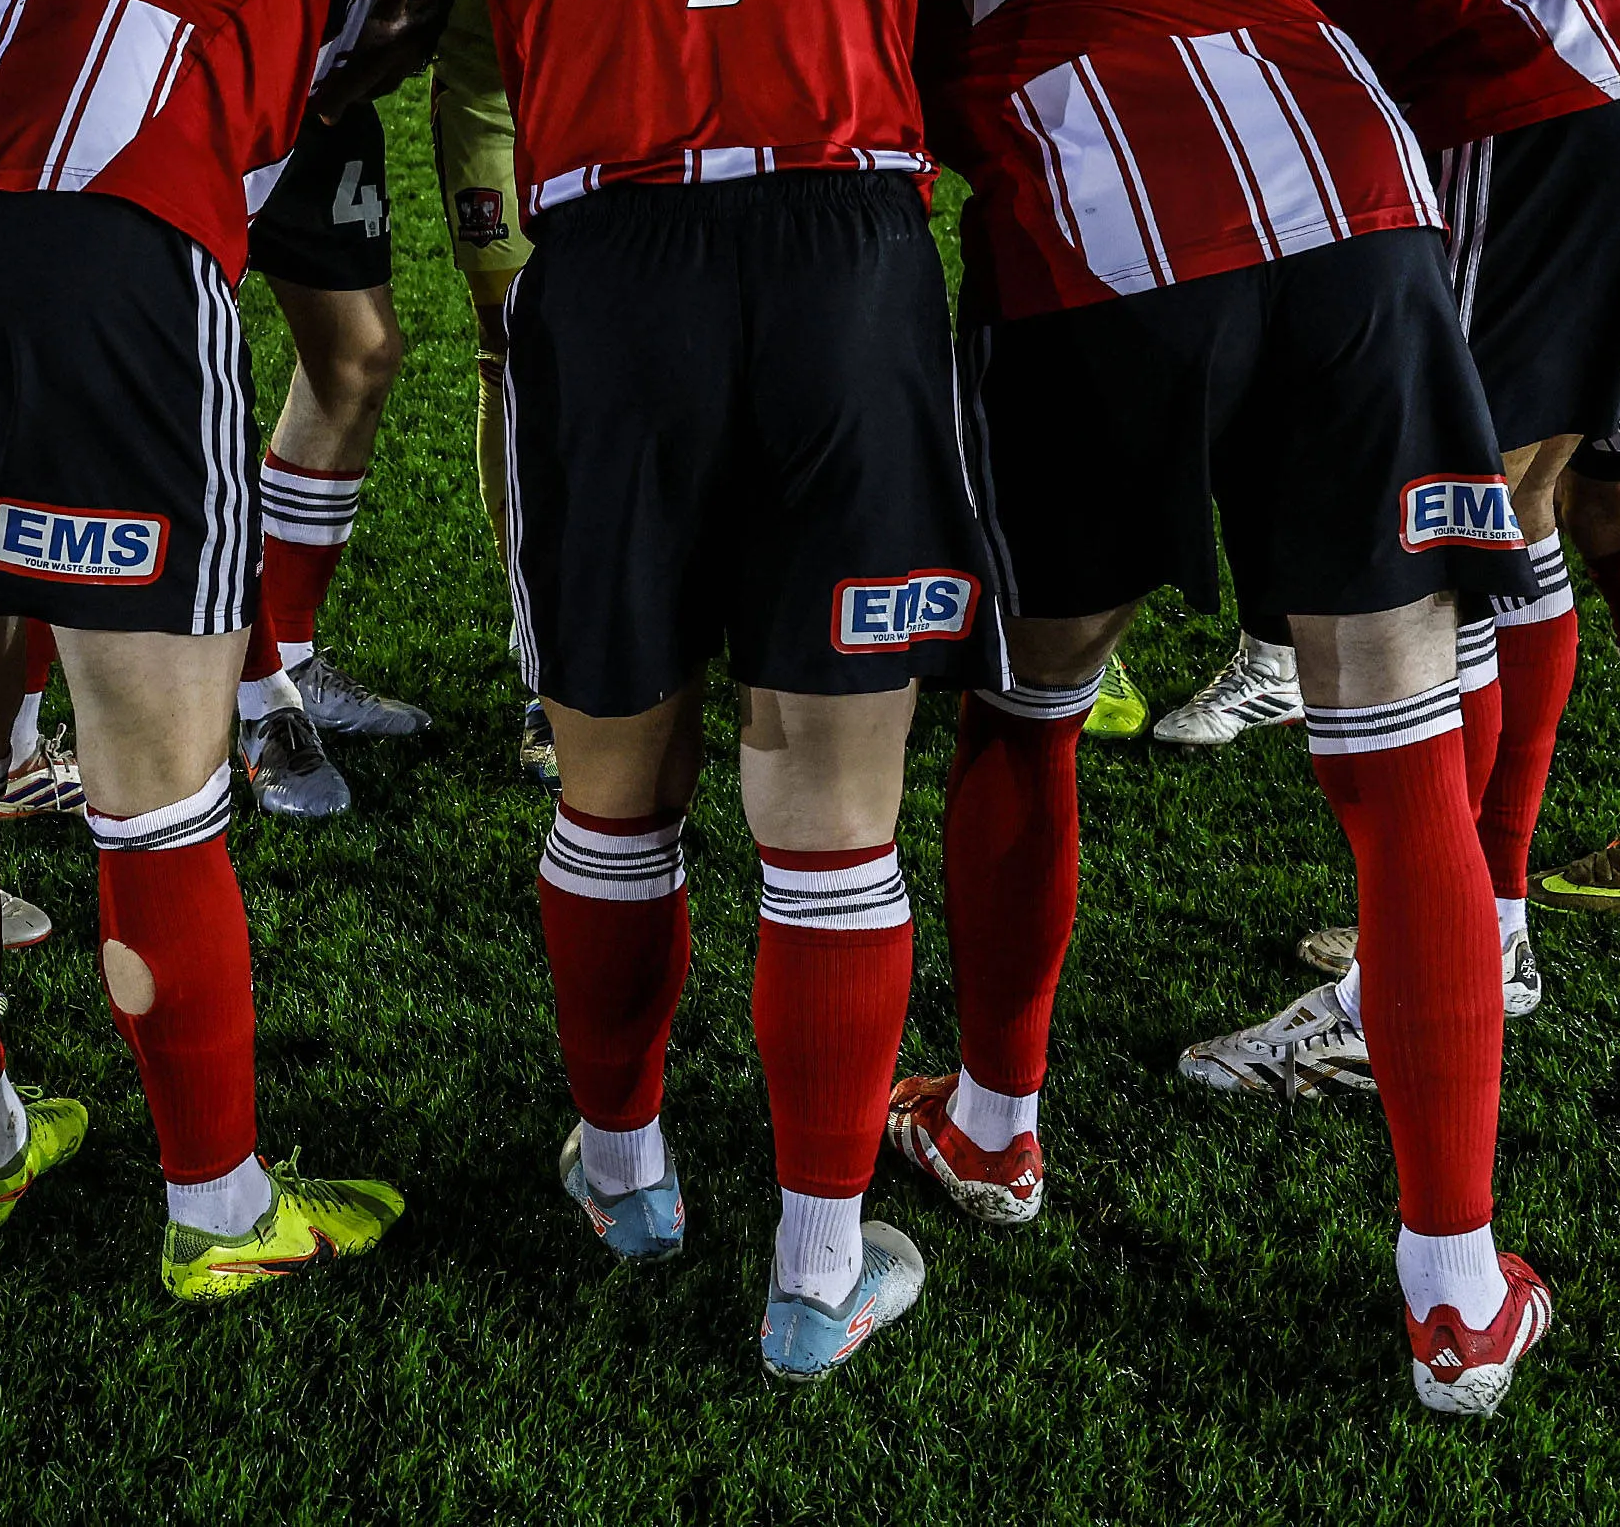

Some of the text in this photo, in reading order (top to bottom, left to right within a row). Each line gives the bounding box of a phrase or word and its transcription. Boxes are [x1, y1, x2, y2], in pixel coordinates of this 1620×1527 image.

[332, 160, 390, 238] 4
[2, 508, 150, 567] EMS
[1433, 526, 1457, 537] YOUR
[1457, 527, 1488, 540] WASTE
[25, 556, 121, 575] YOUR WASTE SORTED
[851, 580, 960, 633] EMS
[873, 633, 896, 642] YOUR
